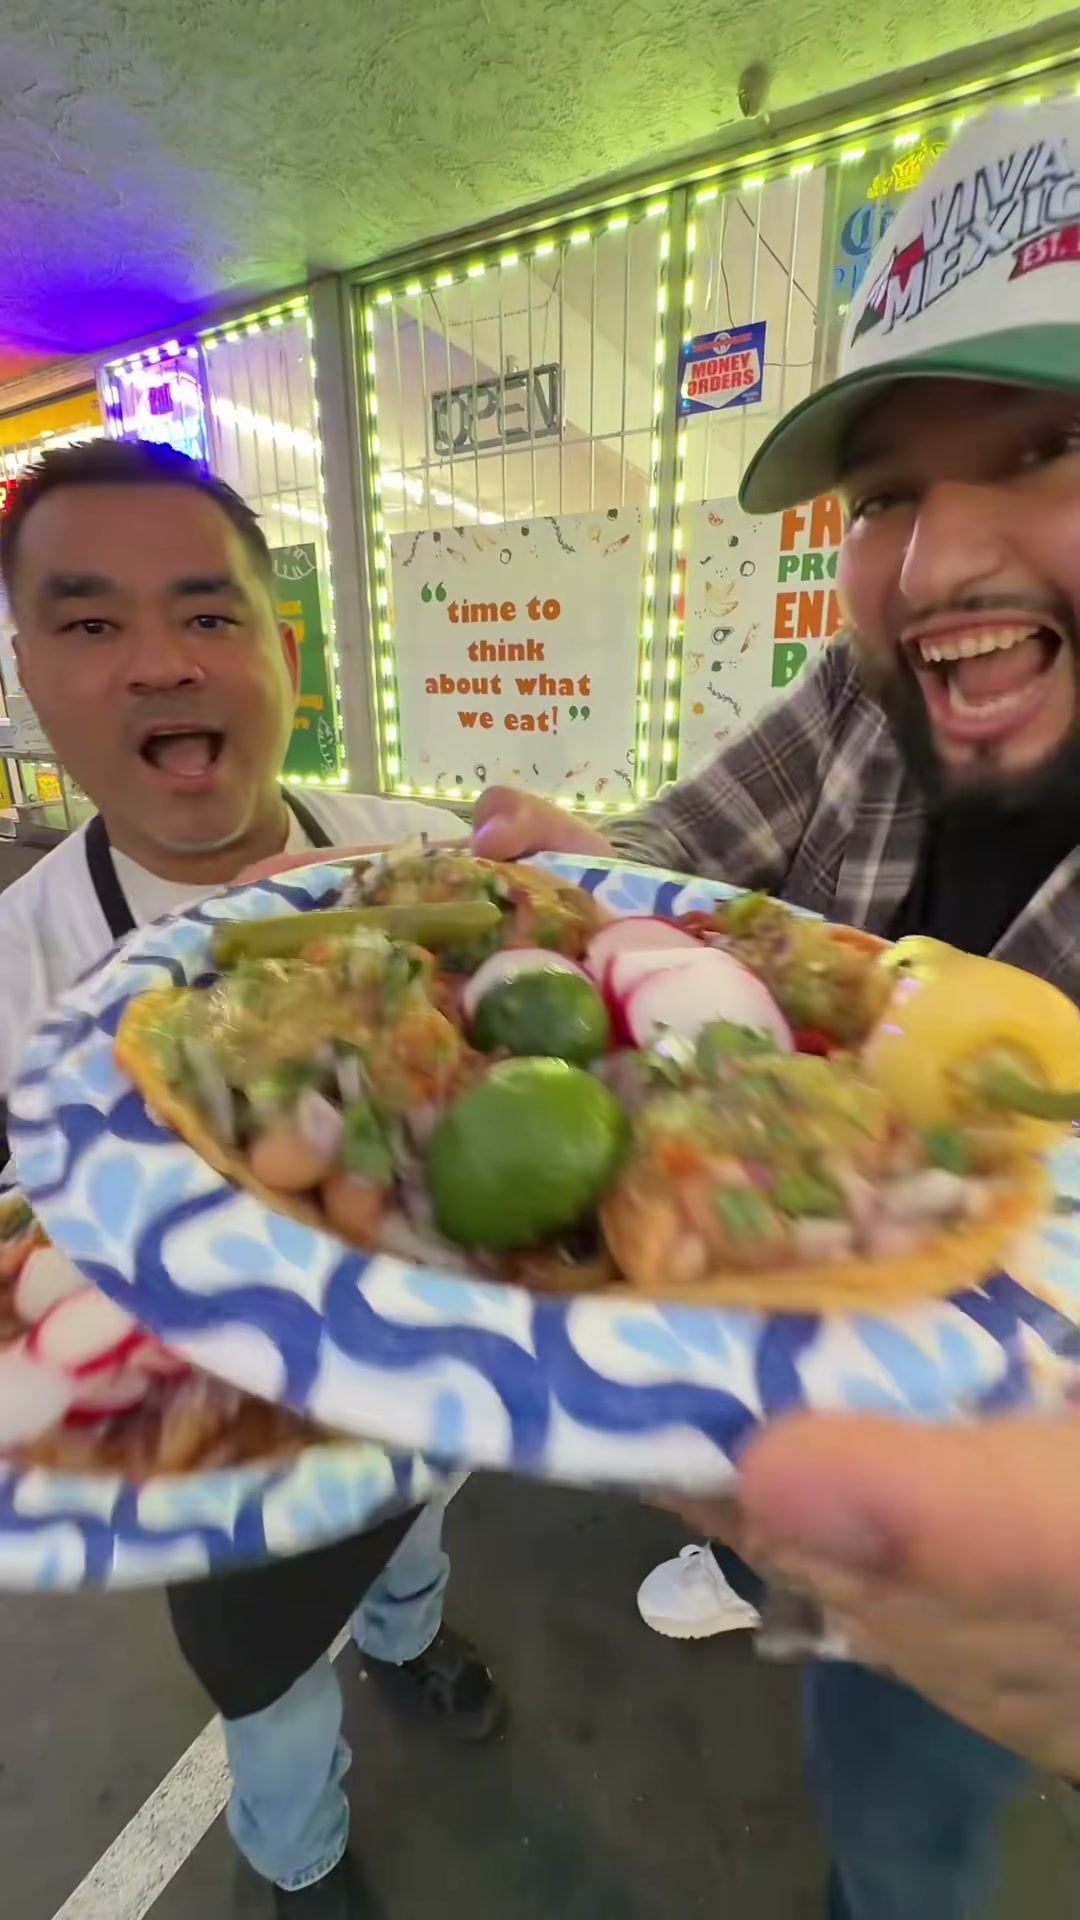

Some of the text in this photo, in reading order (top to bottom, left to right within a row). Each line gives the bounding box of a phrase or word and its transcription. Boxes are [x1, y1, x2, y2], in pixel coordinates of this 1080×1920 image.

[922, 137, 1076, 252] VIVA
[691, 352, 751, 378] MONEY
[687, 369, 754, 397] ORDERS
[434, 370, 559, 449] OPEN
[526, 596, 561, 621] to
[467, 638, 545, 662] think
[425, 673, 591, 696] about what
[457, 711, 494, 729] we
